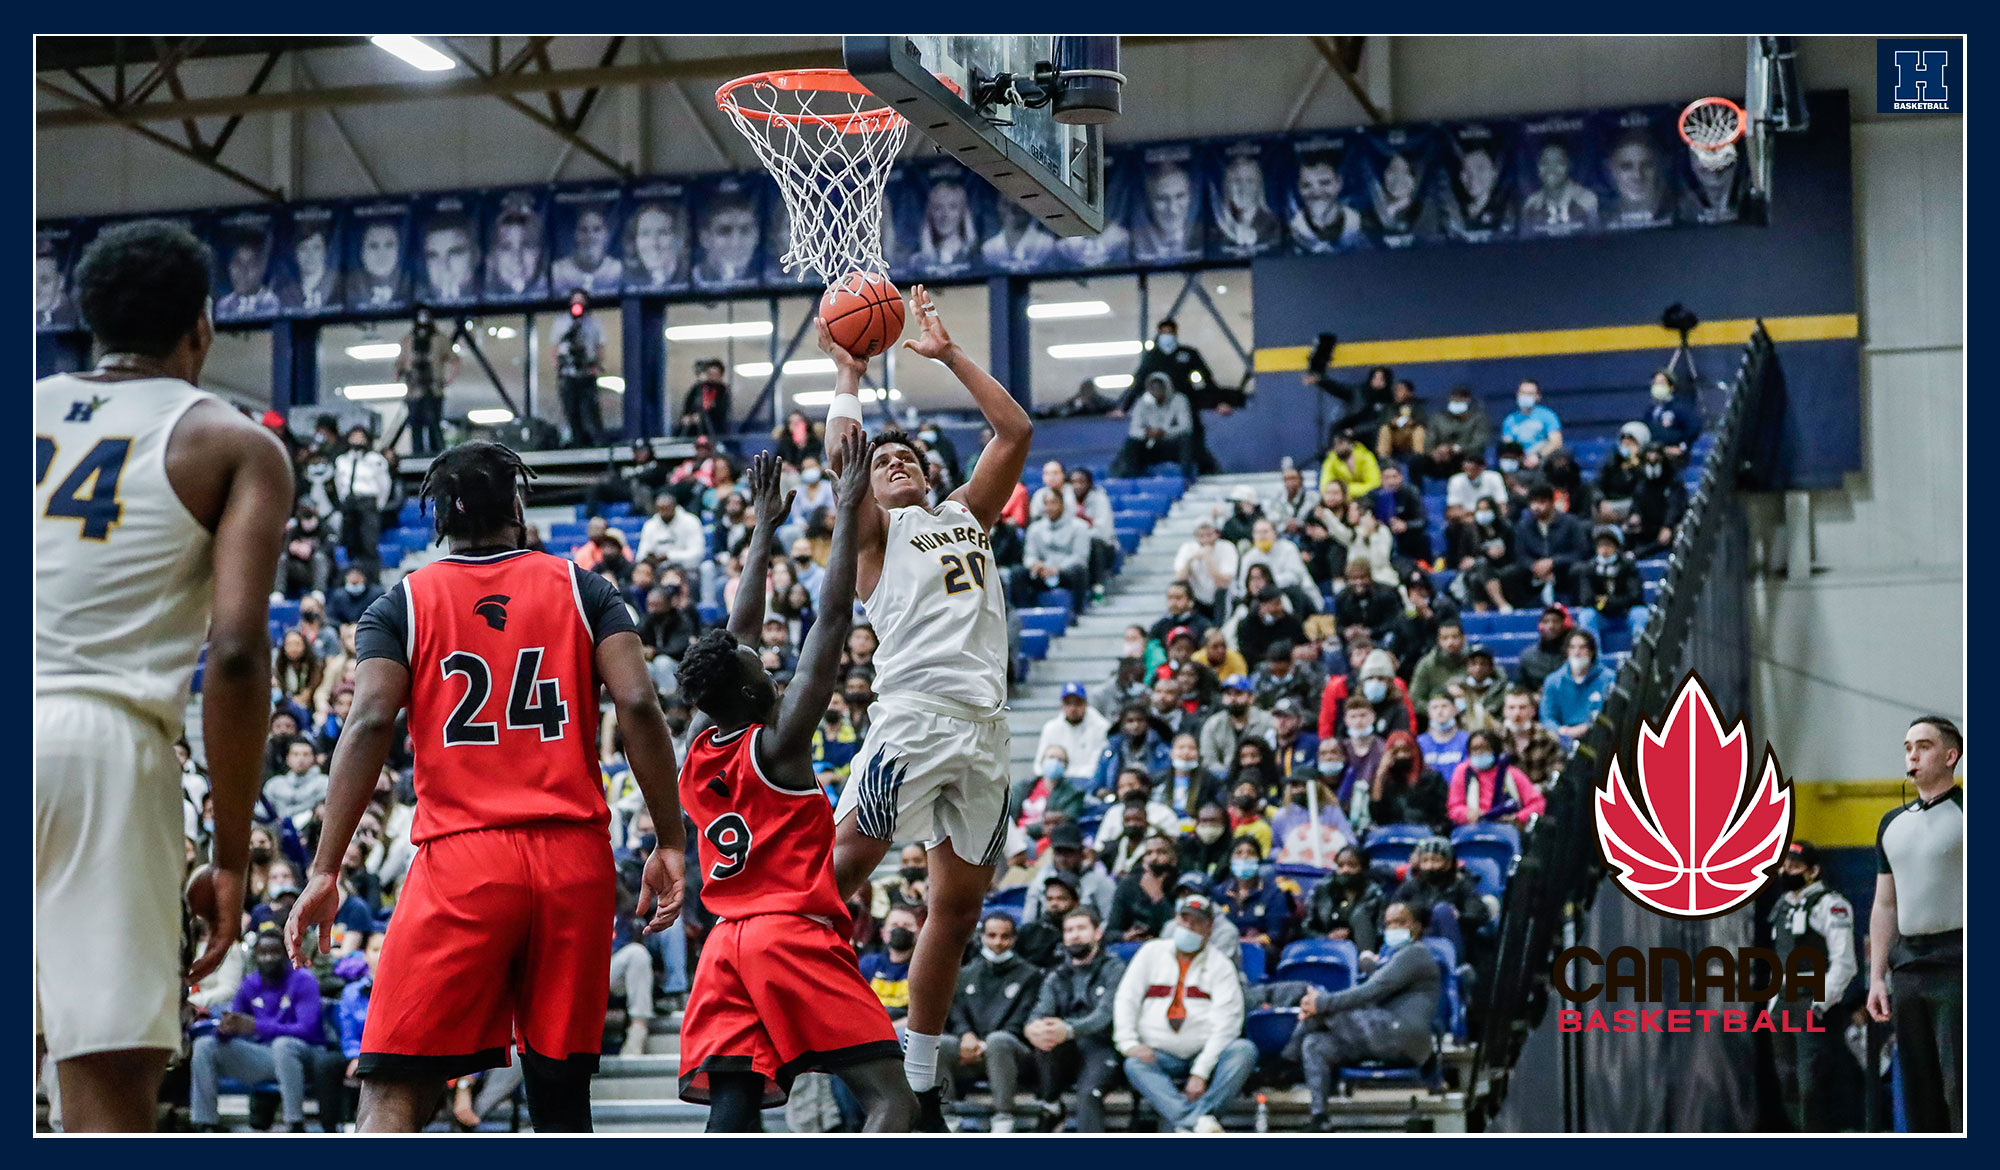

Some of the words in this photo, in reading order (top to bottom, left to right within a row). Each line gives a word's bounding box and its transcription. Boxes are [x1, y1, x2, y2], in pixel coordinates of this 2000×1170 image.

[940, 550, 986, 596] 20
[440, 646, 570, 748] 24
[704, 811, 753, 881] 9
